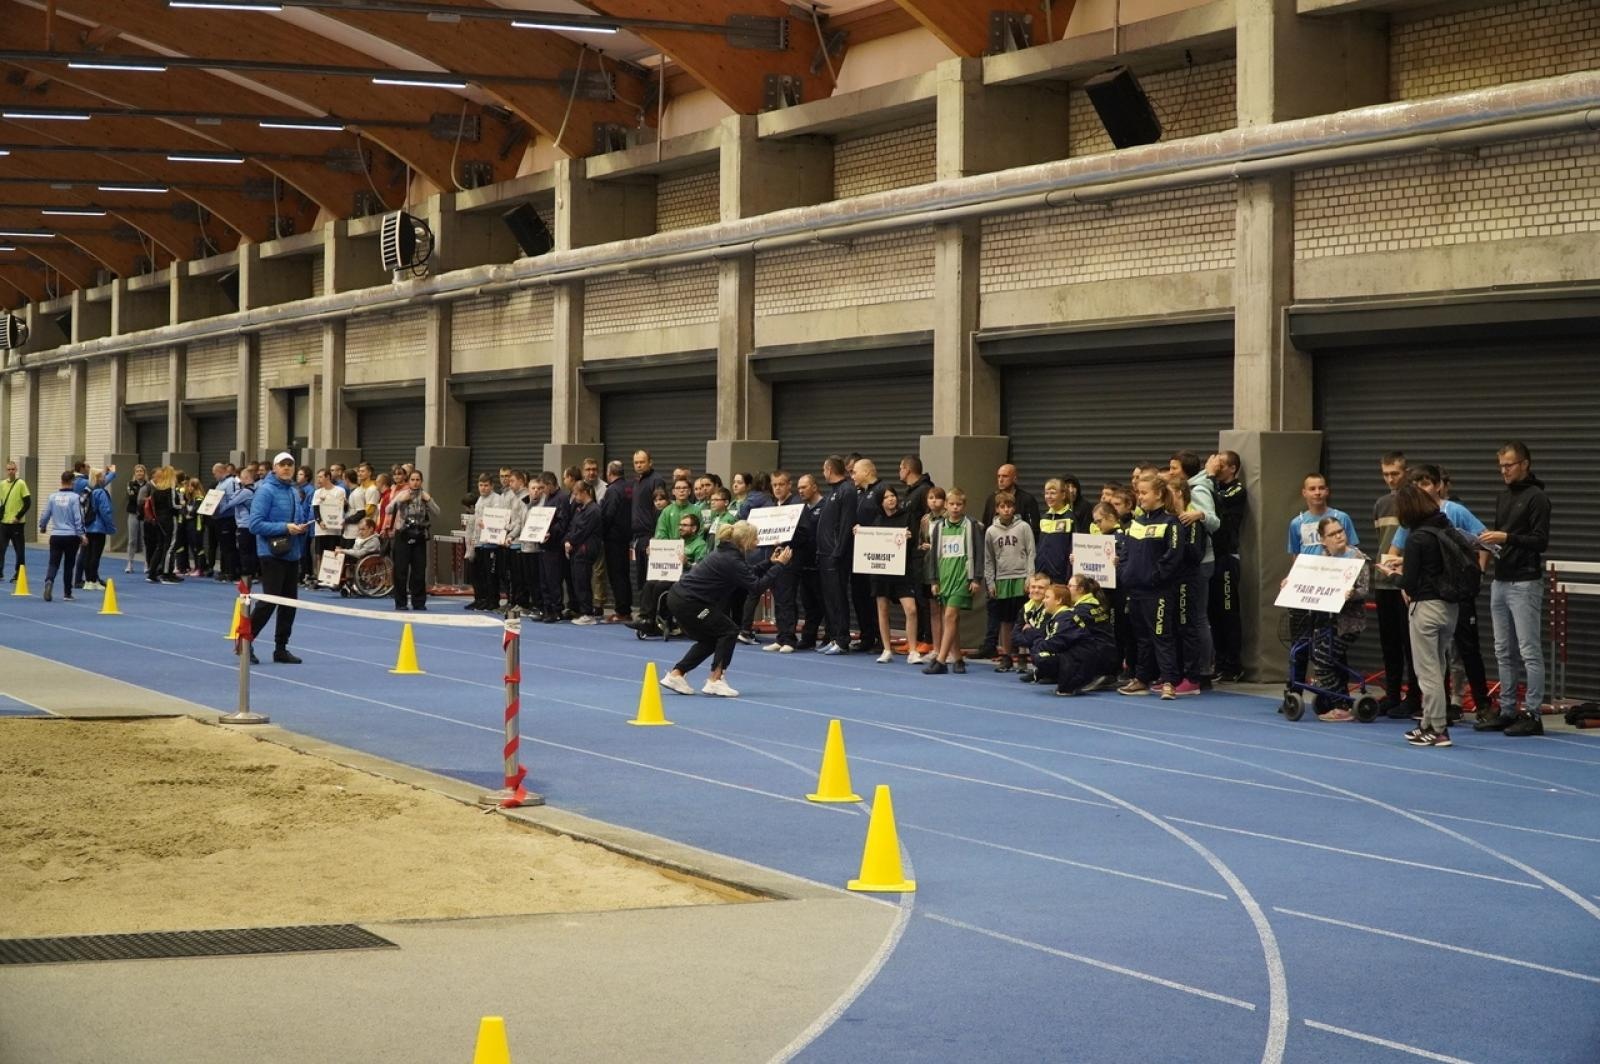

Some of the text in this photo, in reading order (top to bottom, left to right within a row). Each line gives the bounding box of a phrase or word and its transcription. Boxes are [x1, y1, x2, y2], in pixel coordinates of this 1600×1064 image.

[758, 526, 796, 536] EMBIANKA"
[998, 535, 1018, 547] GAP
[1309, 532, 1321, 543] 10
[943, 543, 960, 554] 110
